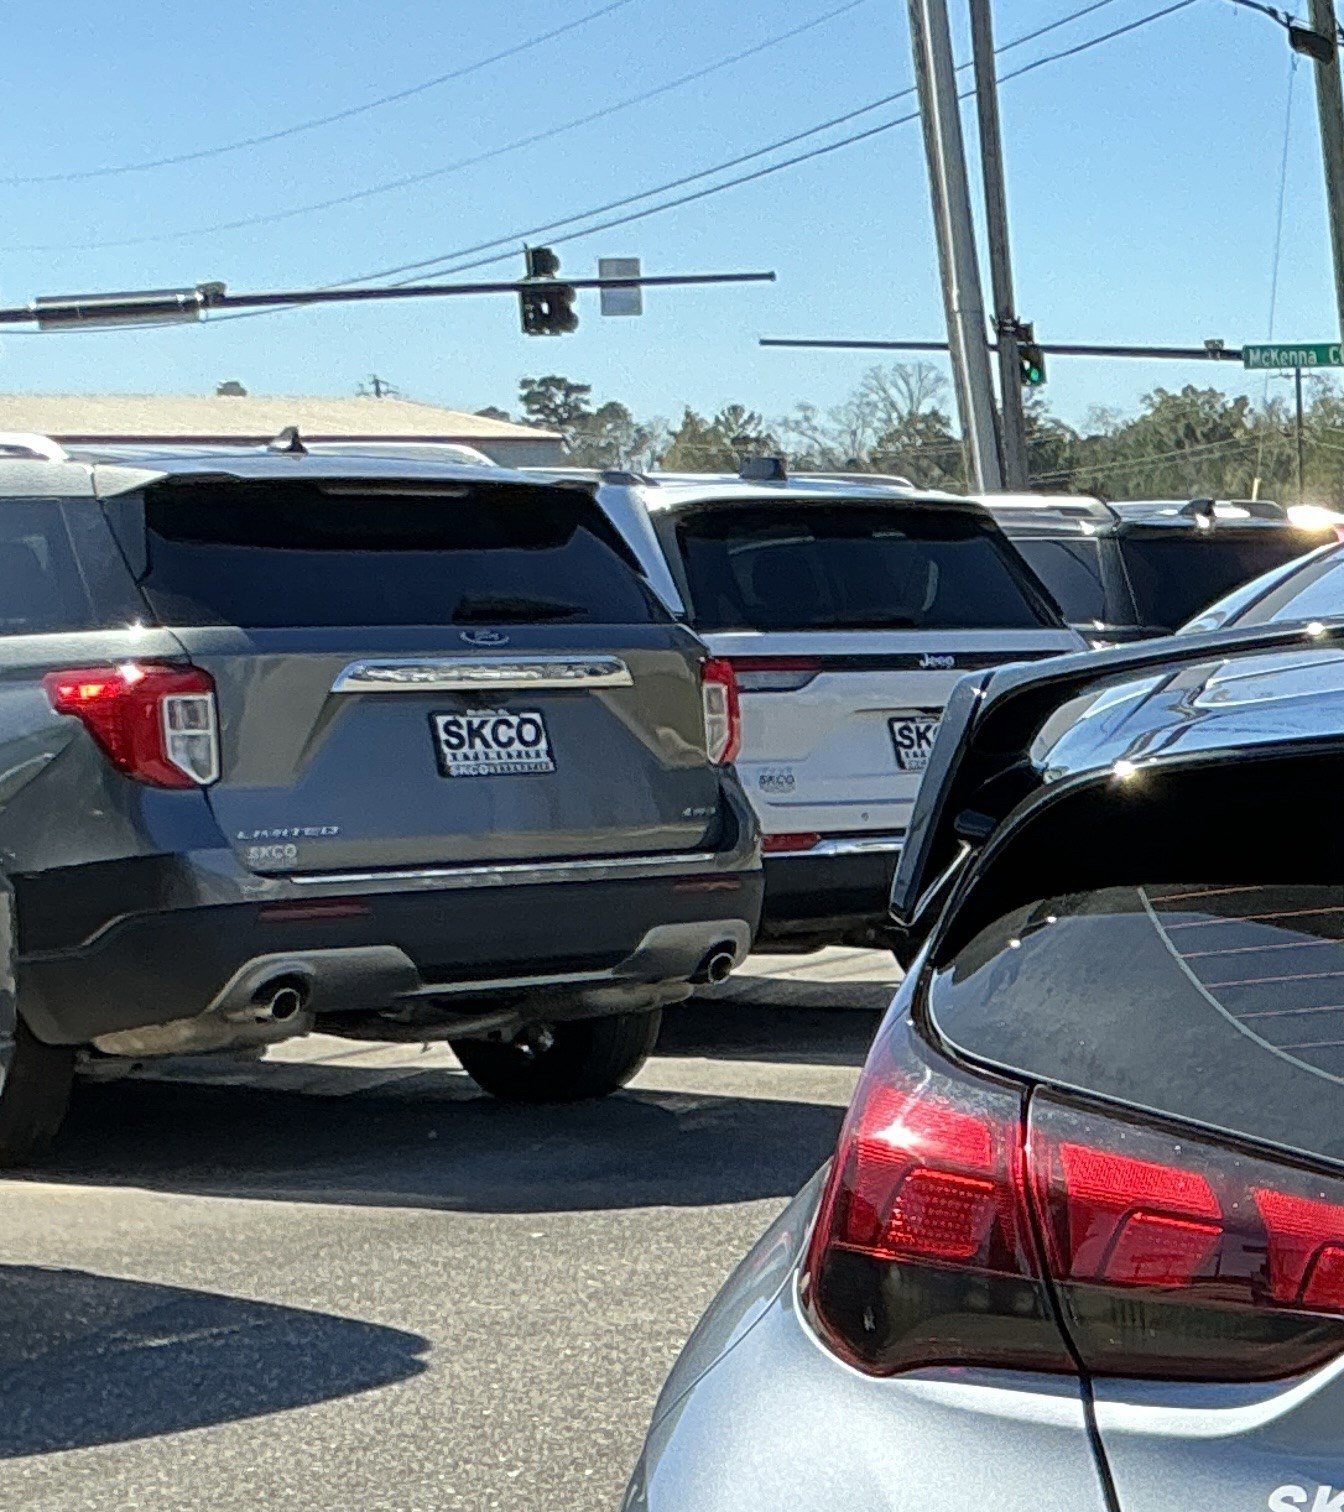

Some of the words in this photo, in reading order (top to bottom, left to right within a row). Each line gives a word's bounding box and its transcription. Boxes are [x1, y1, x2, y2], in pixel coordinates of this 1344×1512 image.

[1249, 348, 1318, 366] McKenna
[443, 717, 542, 750] SKCO
[898, 723, 938, 750] SK
